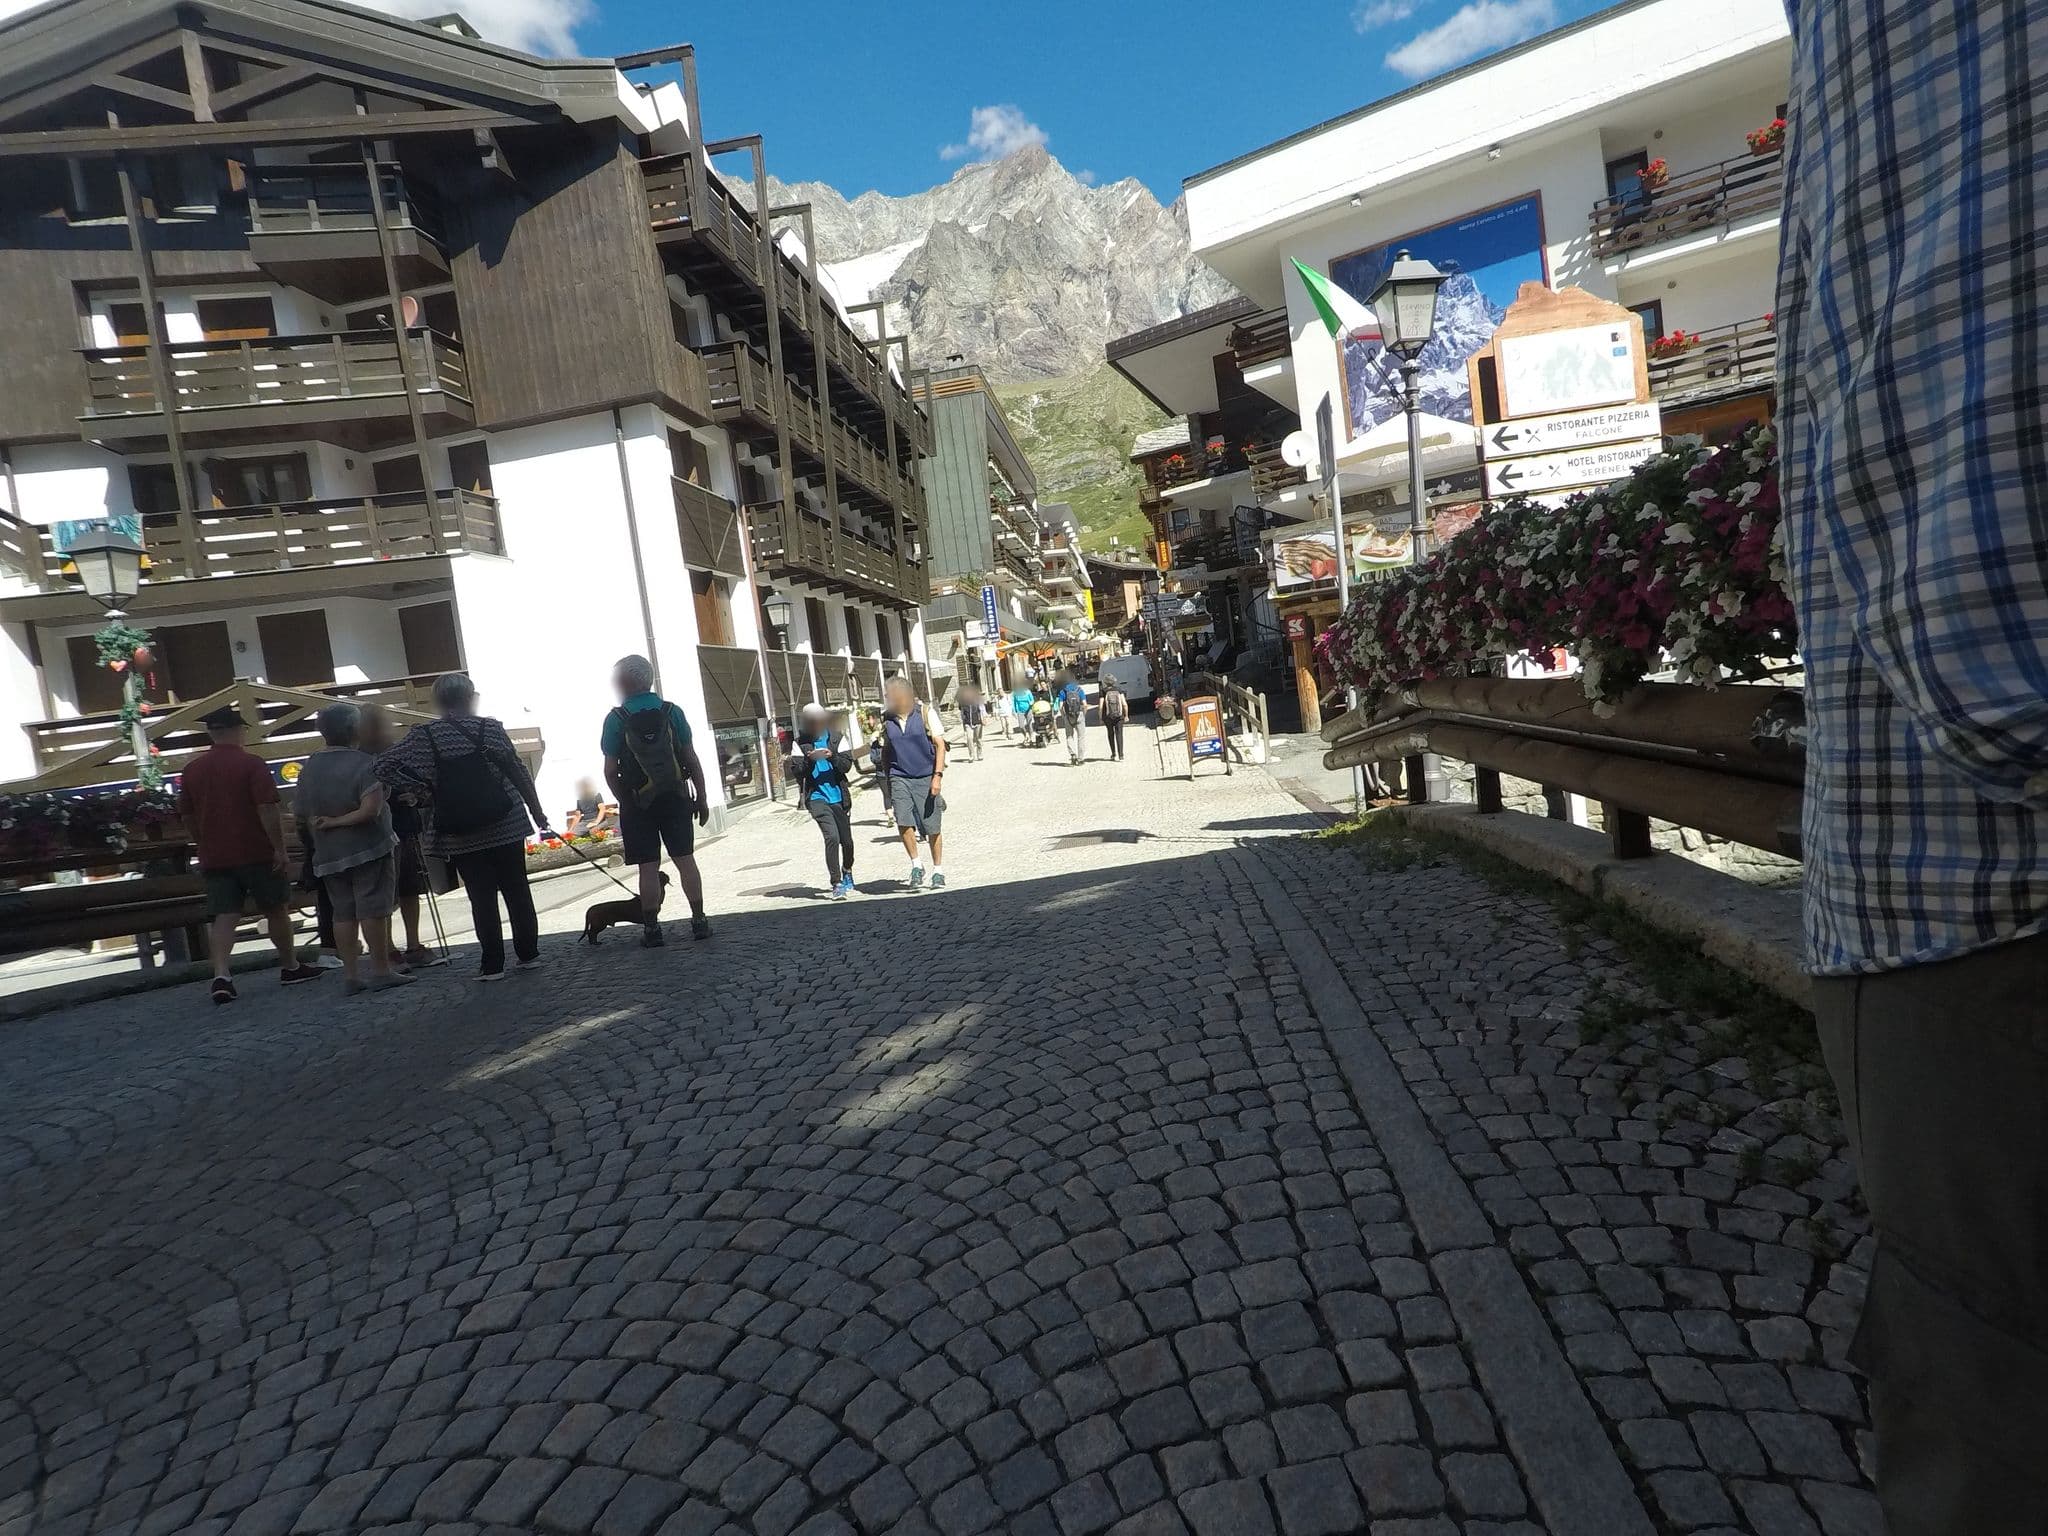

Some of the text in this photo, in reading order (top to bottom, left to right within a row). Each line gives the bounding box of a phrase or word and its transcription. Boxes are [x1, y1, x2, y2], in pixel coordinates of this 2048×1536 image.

[1547, 409, 1650, 432] RISTORANTE PIZZERIA
[1575, 425, 1623, 438] FALCONE
[1567, 447, 1652, 467] HOTEL RISTORANTE
[1581, 464, 1634, 477] SERENEL
